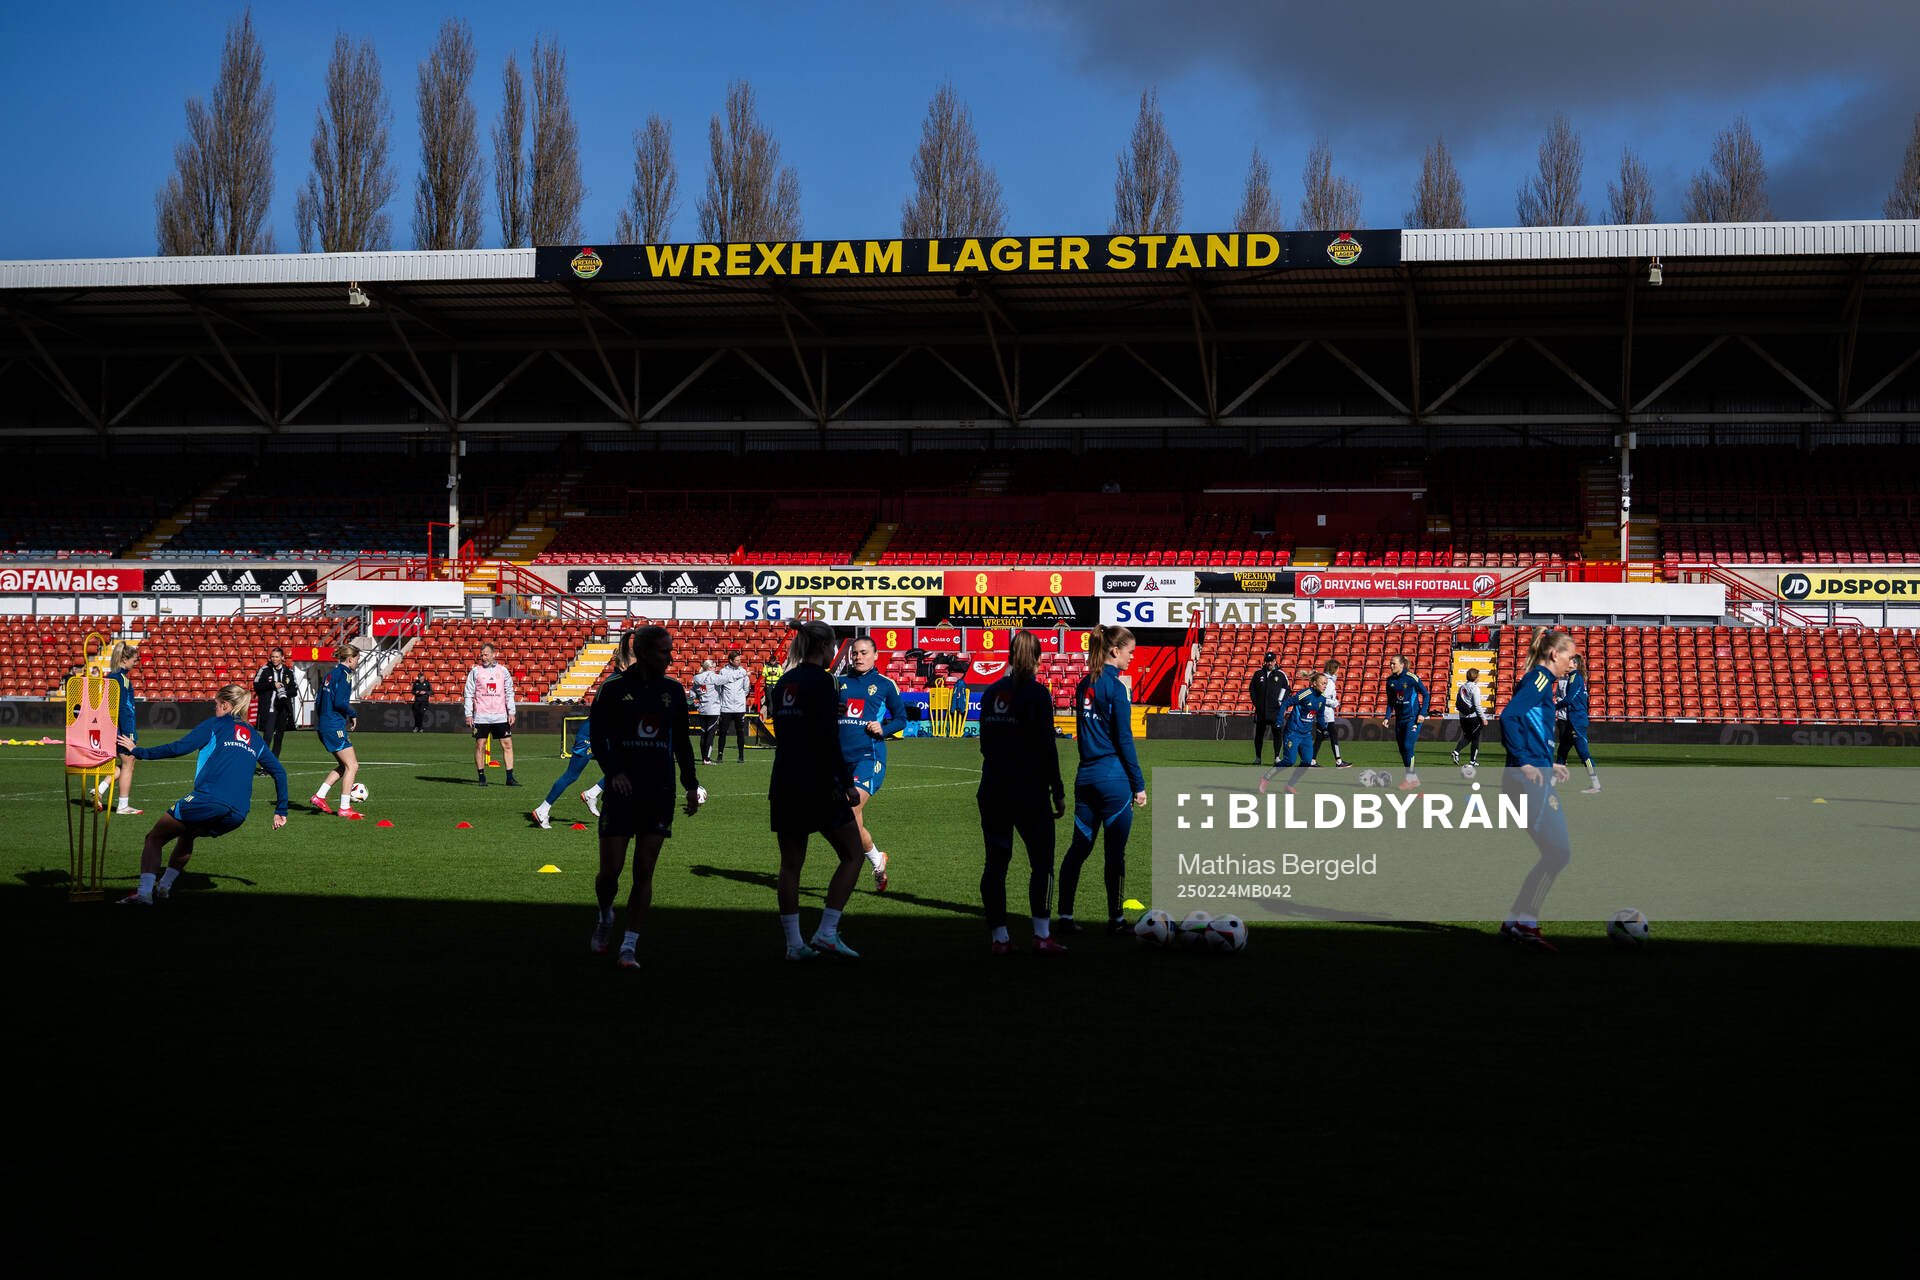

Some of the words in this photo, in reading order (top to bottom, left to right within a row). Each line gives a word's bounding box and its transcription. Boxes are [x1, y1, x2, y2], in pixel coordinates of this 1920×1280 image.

[645, 240, 903, 278] WREXHAM
[927, 236, 1090, 273] LAGER
[1107, 233, 1281, 269] STAND
[0, 569, 119, 591] @FAWales
[1234, 572, 1277, 582] WREXHAM
[151, 583, 181, 592] adidas
[199, 583, 228, 592] adidas
[232, 583, 261, 592] adidas
[279, 583, 308, 592] adidas
[575, 584, 605, 593] adidas
[622, 584, 652, 593] adidas
[667, 584, 698, 593] adidas
[715, 584, 745, 593] adidas
[758, 576, 780, 591] JD
[785, 576, 943, 590] JDSPORTS.COM
[1106, 579, 1137, 589] genero
[1302, 578, 1321, 592] MG
[1324, 579, 1371, 590] DRIVING
[1374, 579, 1412, 590] WELSH
[1415, 579, 1470, 590] FOOTBALL
[1785, 579, 1808, 595] JD
[1815, 579, 1920, 594] JDSPORT
[744, 600, 781, 620] SG
[794, 600, 916, 622] ESTATES
[949, 596, 1059, 616] MINERA
[1116, 601, 1154, 623] SG
[1168, 602, 1297, 623] ESTATES
[983, 618, 1024, 628] WREXHAM
[1793, 730, 1874, 746] SHOP
